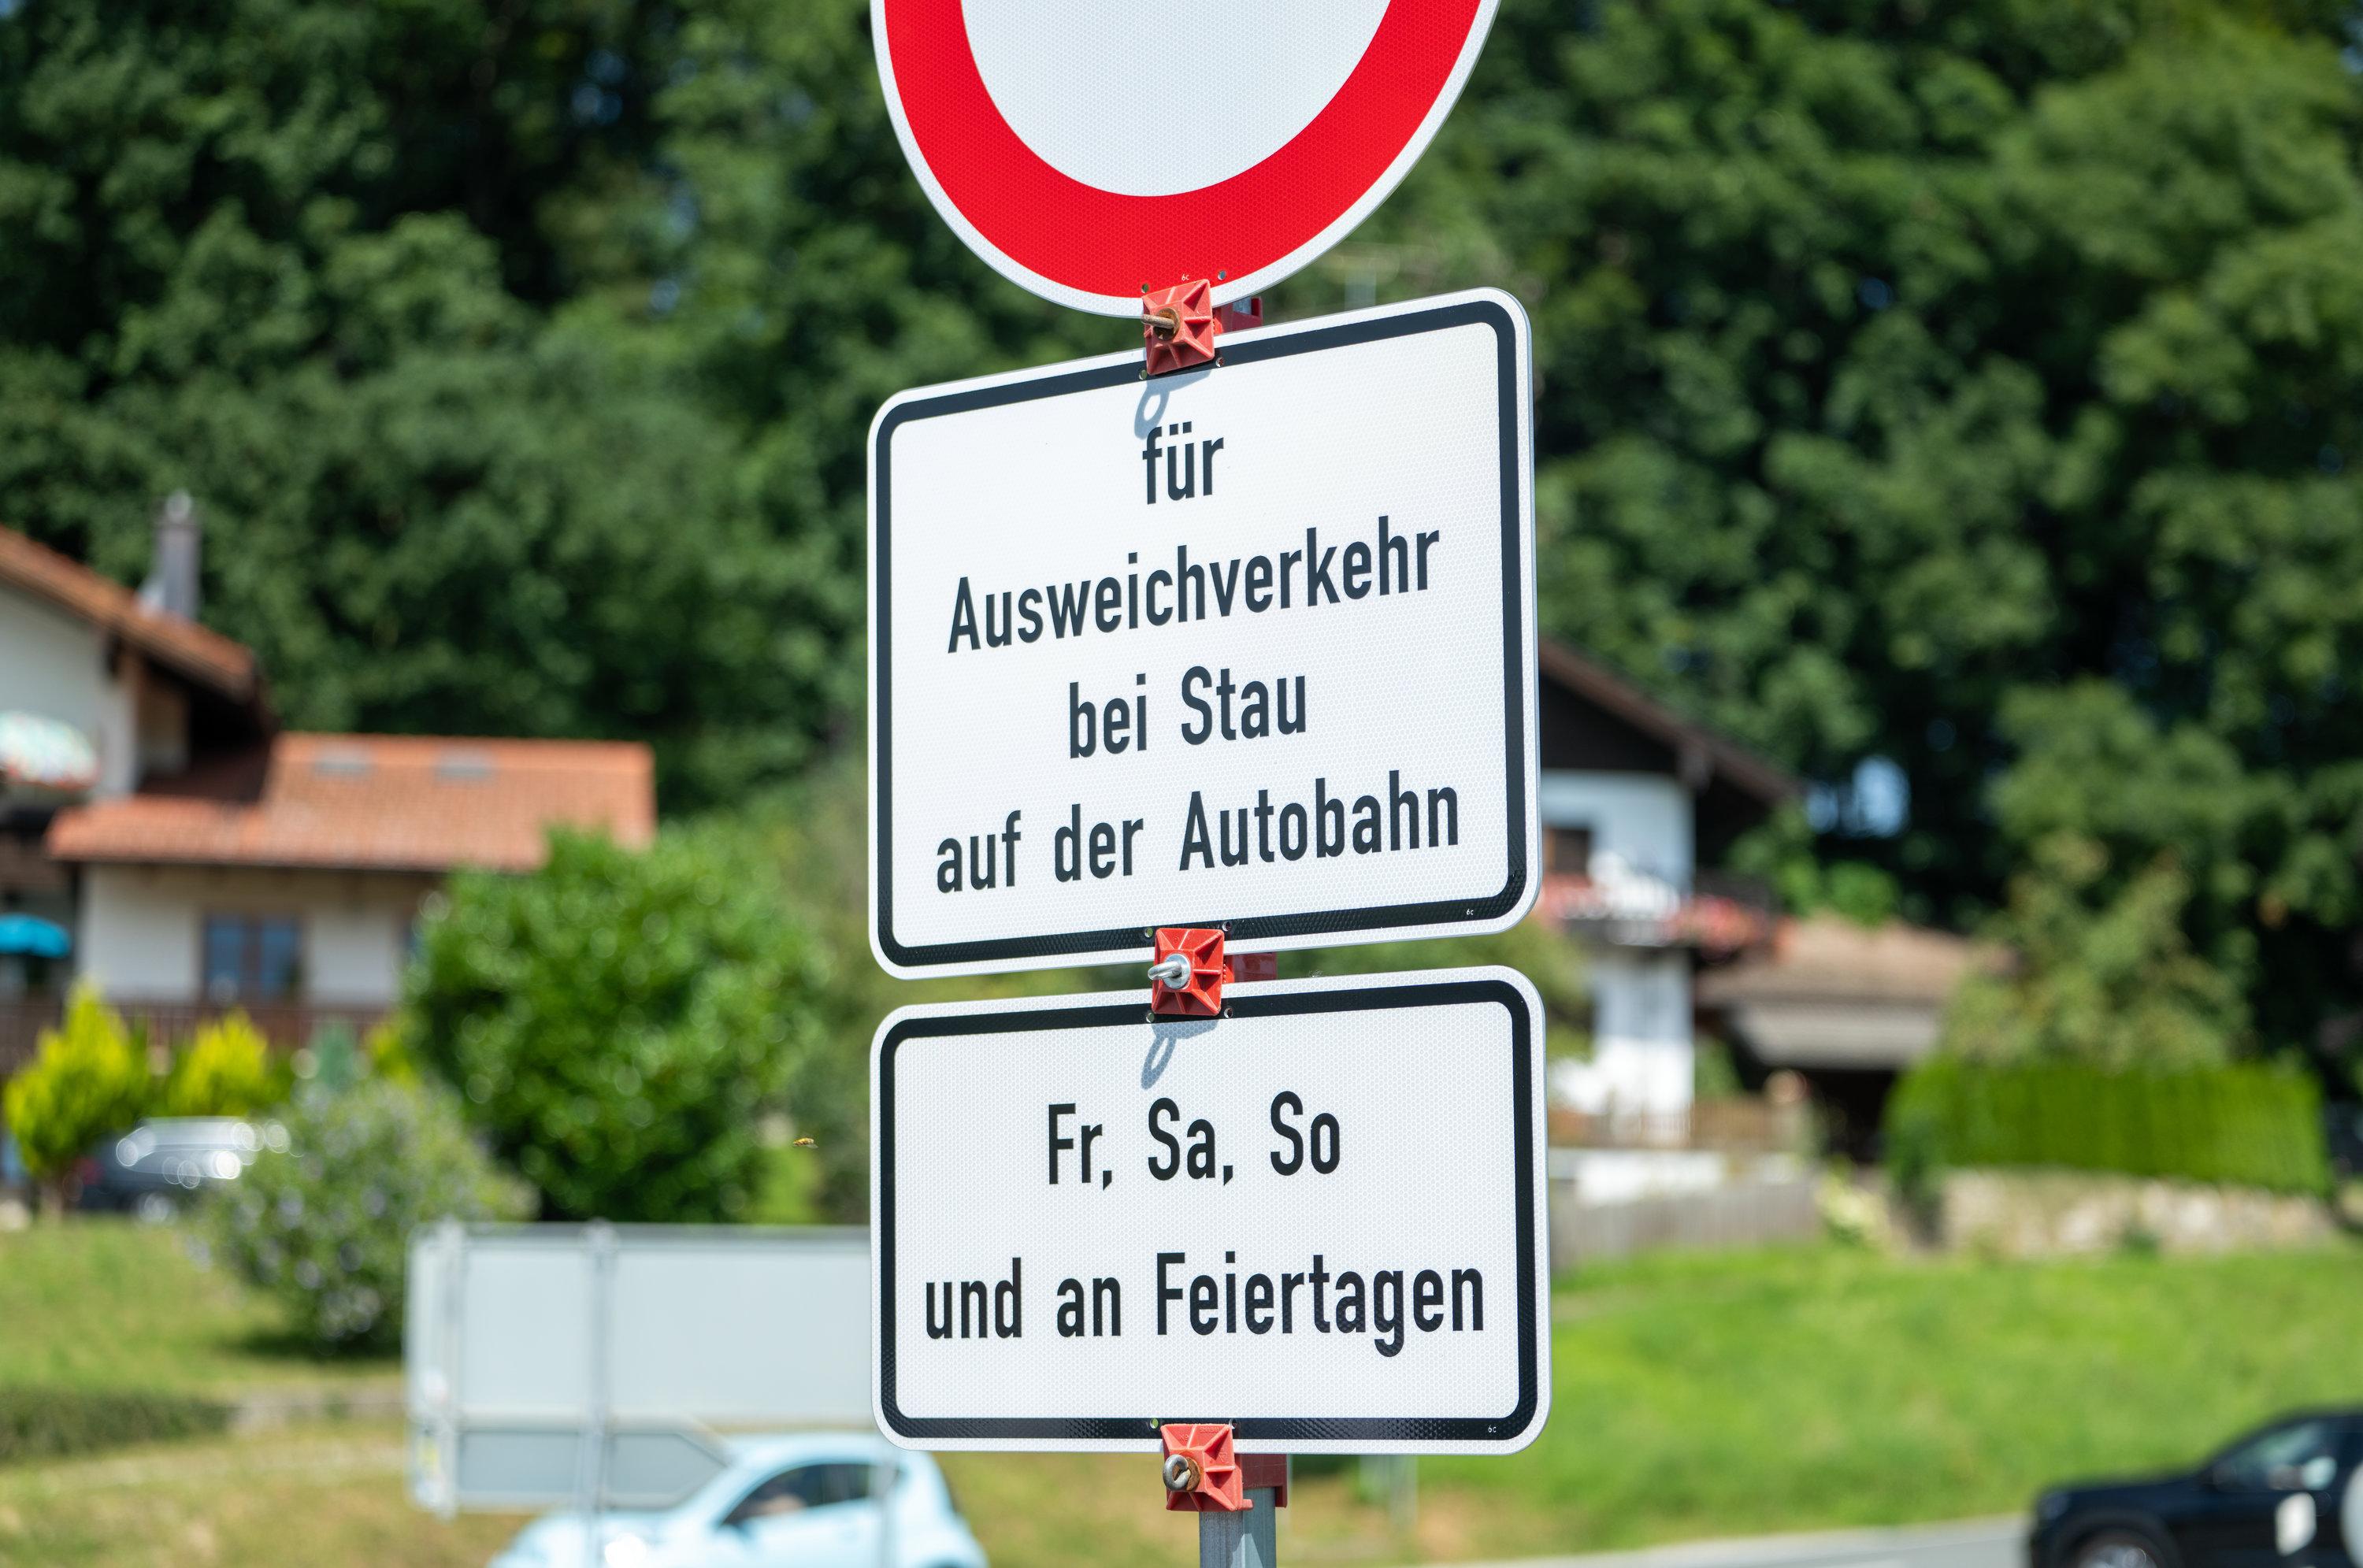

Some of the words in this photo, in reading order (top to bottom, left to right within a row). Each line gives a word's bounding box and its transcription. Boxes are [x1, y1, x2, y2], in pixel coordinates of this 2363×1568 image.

[1143, 421, 1223, 504] für
[948, 516, 1438, 653] Ausweichverkehr
[1070, 673, 1145, 758] bei
[1182, 666, 1305, 744] Stau
[937, 810, 1020, 892] auf
[1055, 804, 1143, 882] der
[1180, 770, 1457, 870] Autobahn
[1049, 1103, 1111, 1190] Fr,
[1148, 1098, 1233, 1185] Sa,
[1271, 1092, 1340, 1176] So
[926, 1258, 1021, 1339] und
[1057, 1277, 1120, 1337] an
[1157, 1251, 1483, 1357] Feiertagen
